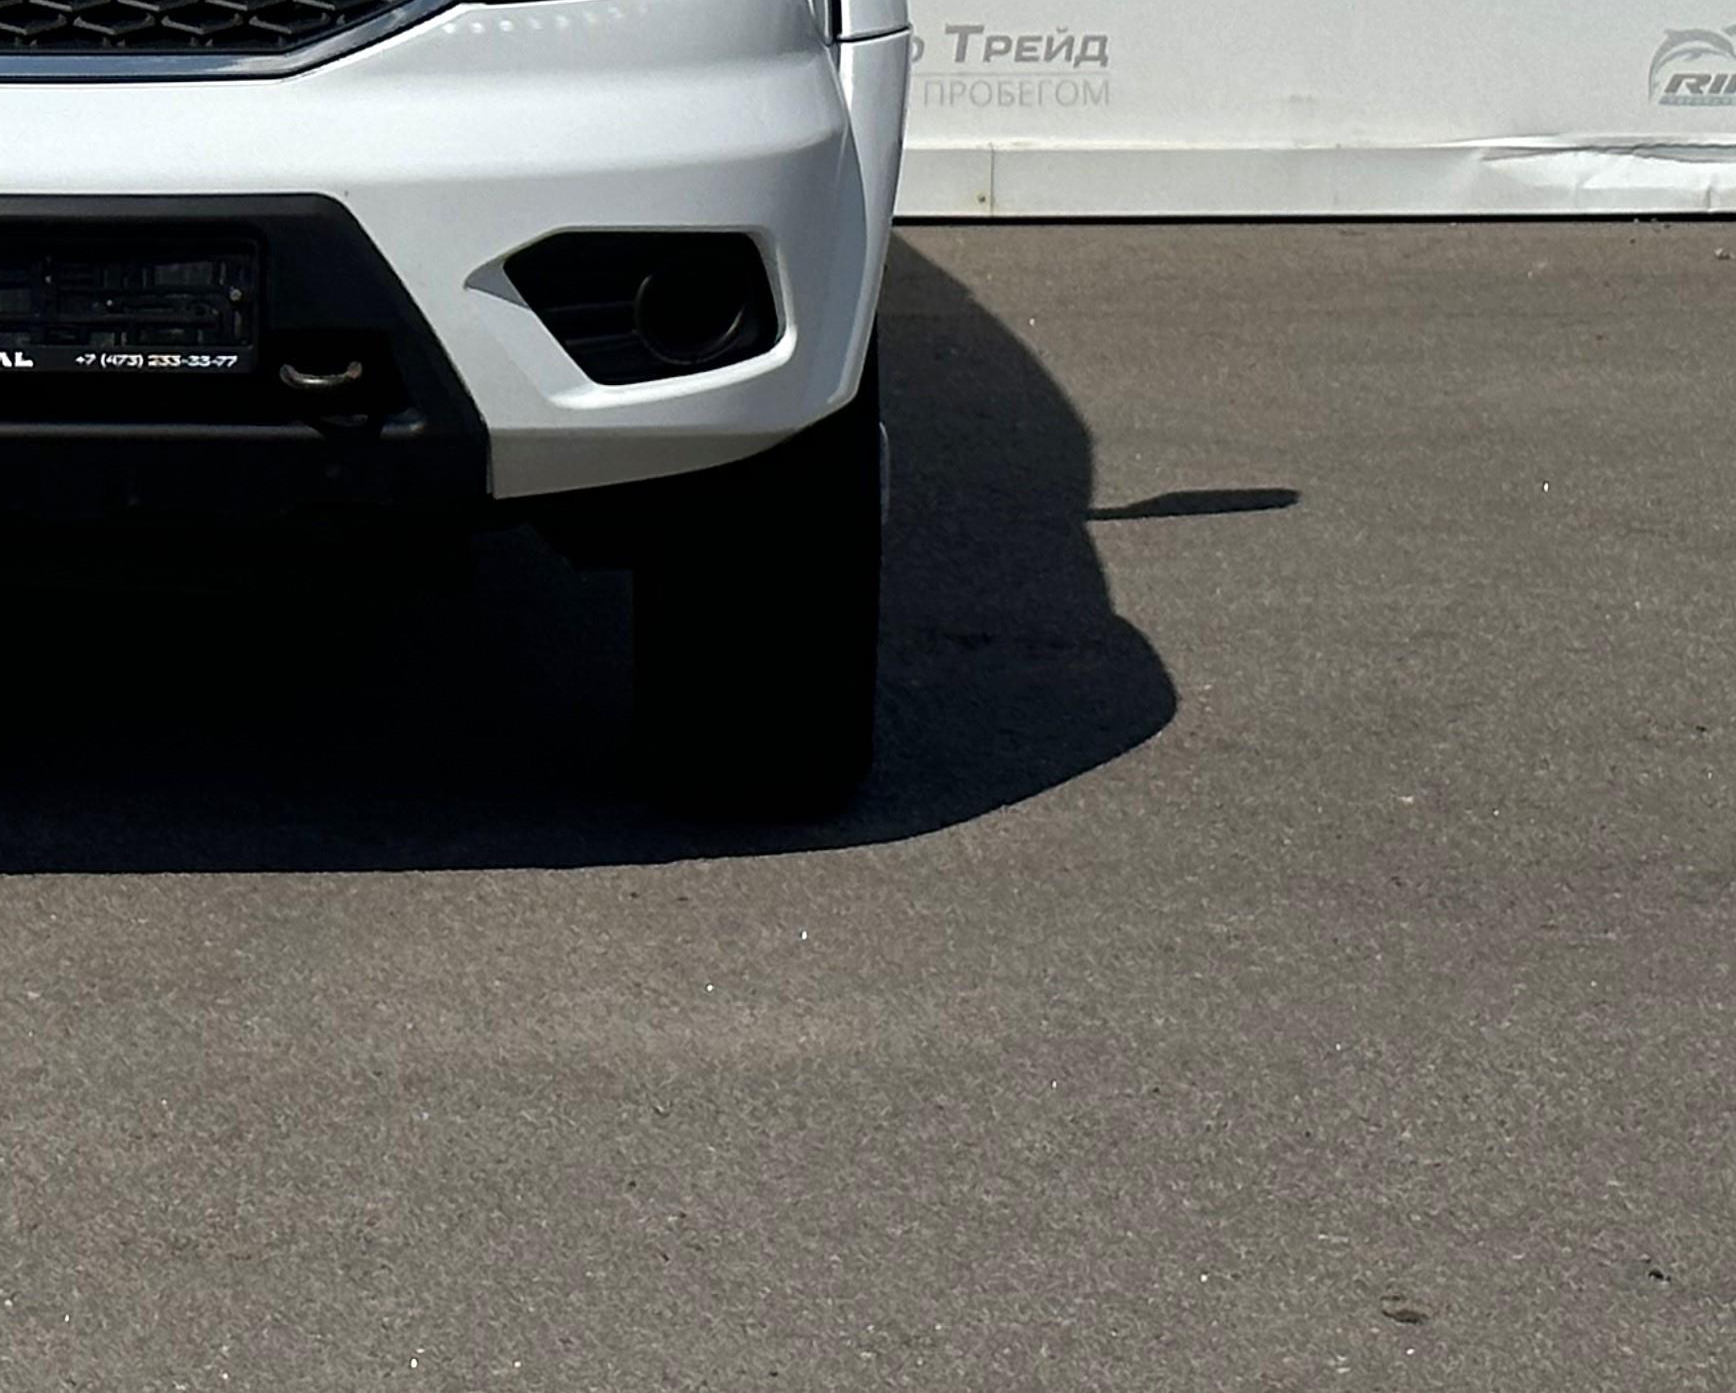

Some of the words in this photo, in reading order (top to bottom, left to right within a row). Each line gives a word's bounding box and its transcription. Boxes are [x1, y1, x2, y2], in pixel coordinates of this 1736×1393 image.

[945, 24, 1108, 67] Трейд
[925, 80, 1109, 106] ПРОБЕГОМ
[75, 352, 97, 366] +7
[100, 352, 144, 369] (473)
[147, 354, 238, 367] 233-33-77
